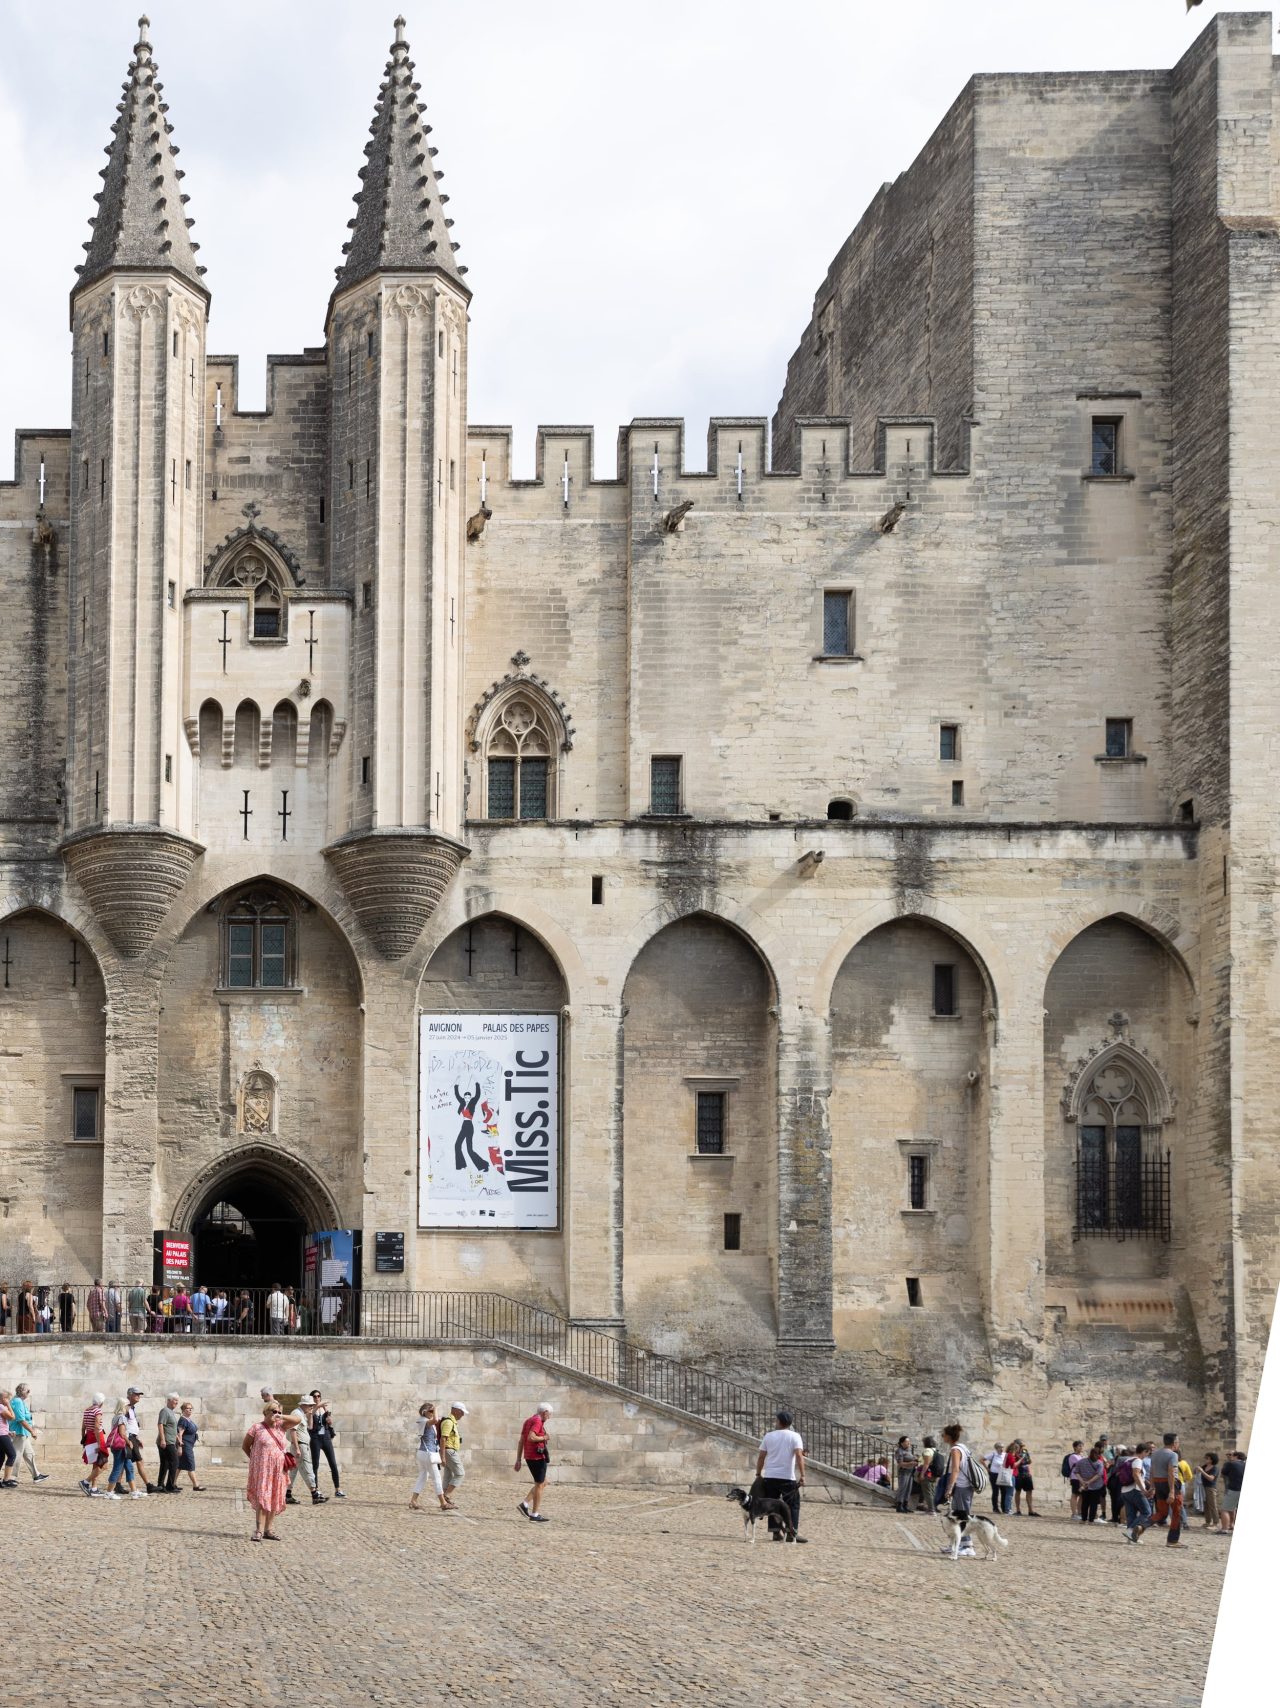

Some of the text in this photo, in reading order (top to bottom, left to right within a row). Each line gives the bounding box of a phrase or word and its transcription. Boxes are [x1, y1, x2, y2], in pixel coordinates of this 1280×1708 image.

[428, 1023, 462, 1032] AVIGNON
[483, 1023, 550, 1032] PALAIS DES PAPES
[504, 1051, 549, 1192] Miss.Tic
